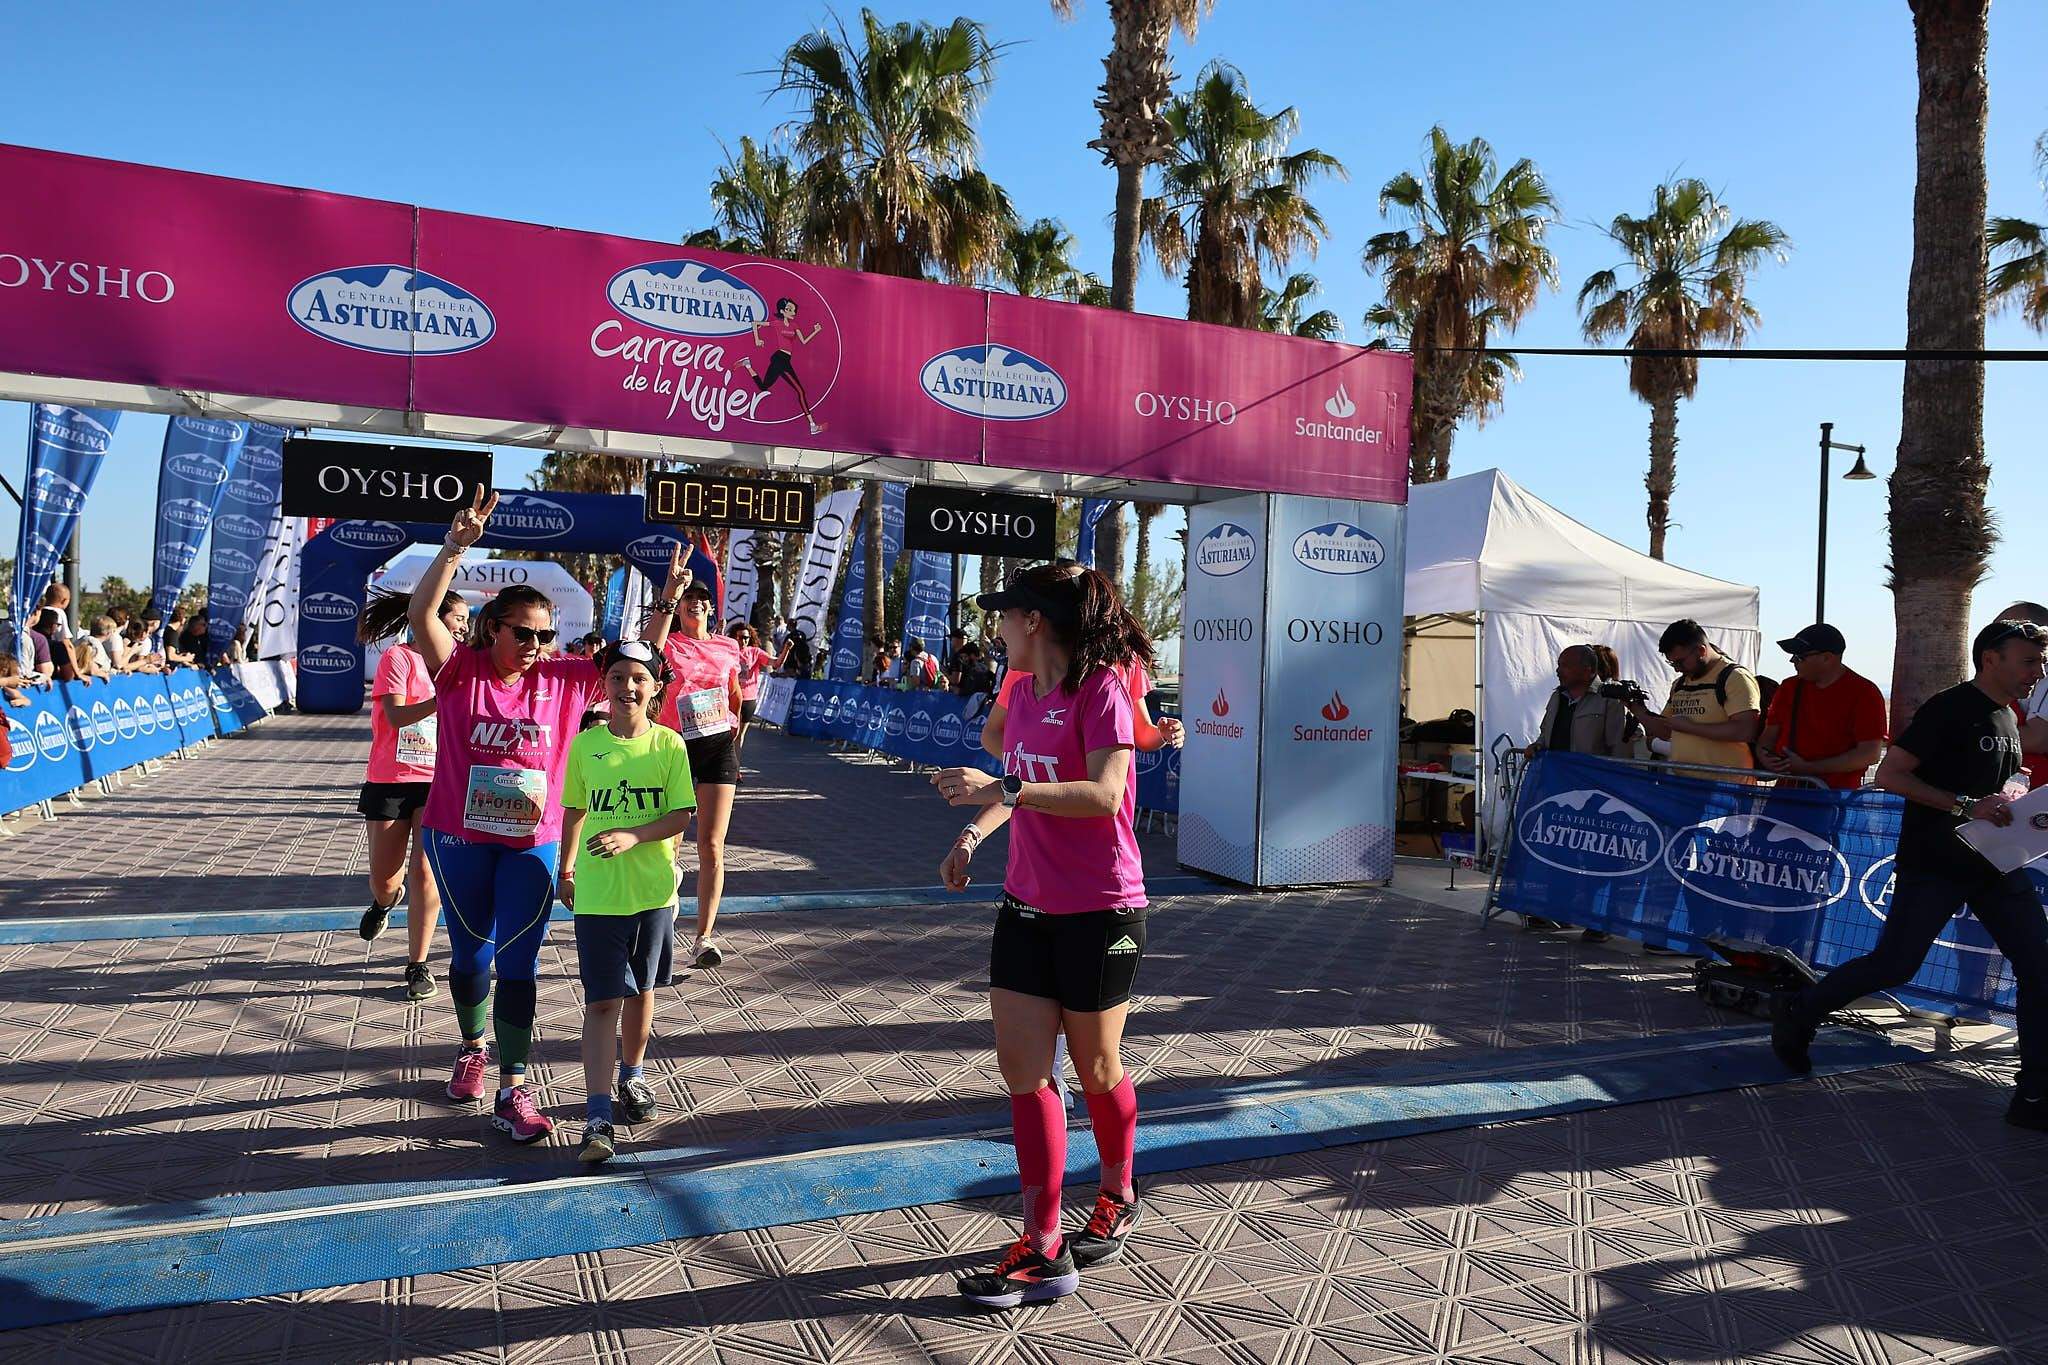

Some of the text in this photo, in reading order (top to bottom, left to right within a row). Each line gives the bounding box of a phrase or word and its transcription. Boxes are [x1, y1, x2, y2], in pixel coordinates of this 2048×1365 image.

[0, 254, 175, 303] OYSHO
[645, 280, 751, 302] CENTRAL LECHERA
[338, 290, 401, 306] CENTRAL
[619, 279, 754, 323] ASTURIANA
[304, 290, 481, 338] ASTURIANA
[590, 320, 724, 371] Carrera
[931, 366, 1056, 405] ASTURIANA
[1006, 373, 1052, 385] LECHERA
[623, 365, 771, 432] de la Mujer
[1134, 391, 1237, 426] OYSHO
[1295, 417, 1382, 444] Santander
[318, 465, 464, 502] OYSHO
[658, 481, 802, 523] 00:39:00
[489, 513, 566, 530] STURIANA
[930, 508, 1035, 538] OYSHO
[1200, 545, 1251, 565] ASTURIANA
[1299, 539, 1377, 563] ASTURIANA
[796, 513, 845, 641] OYSHO
[1193, 617, 1253, 642] OYSHO
[1288, 618, 1383, 645] OYSHO
[1195, 718, 1244, 739] Santander
[1294, 725, 1373, 742] Santander
[1526, 812, 1648, 863] ASTURIANA
[1551, 813, 1650, 836] CENTRAL LECHERA
[1706, 838, 1830, 866] CENTRAL LECHERA
[1674, 837, 1834, 897] ASTURIANA
